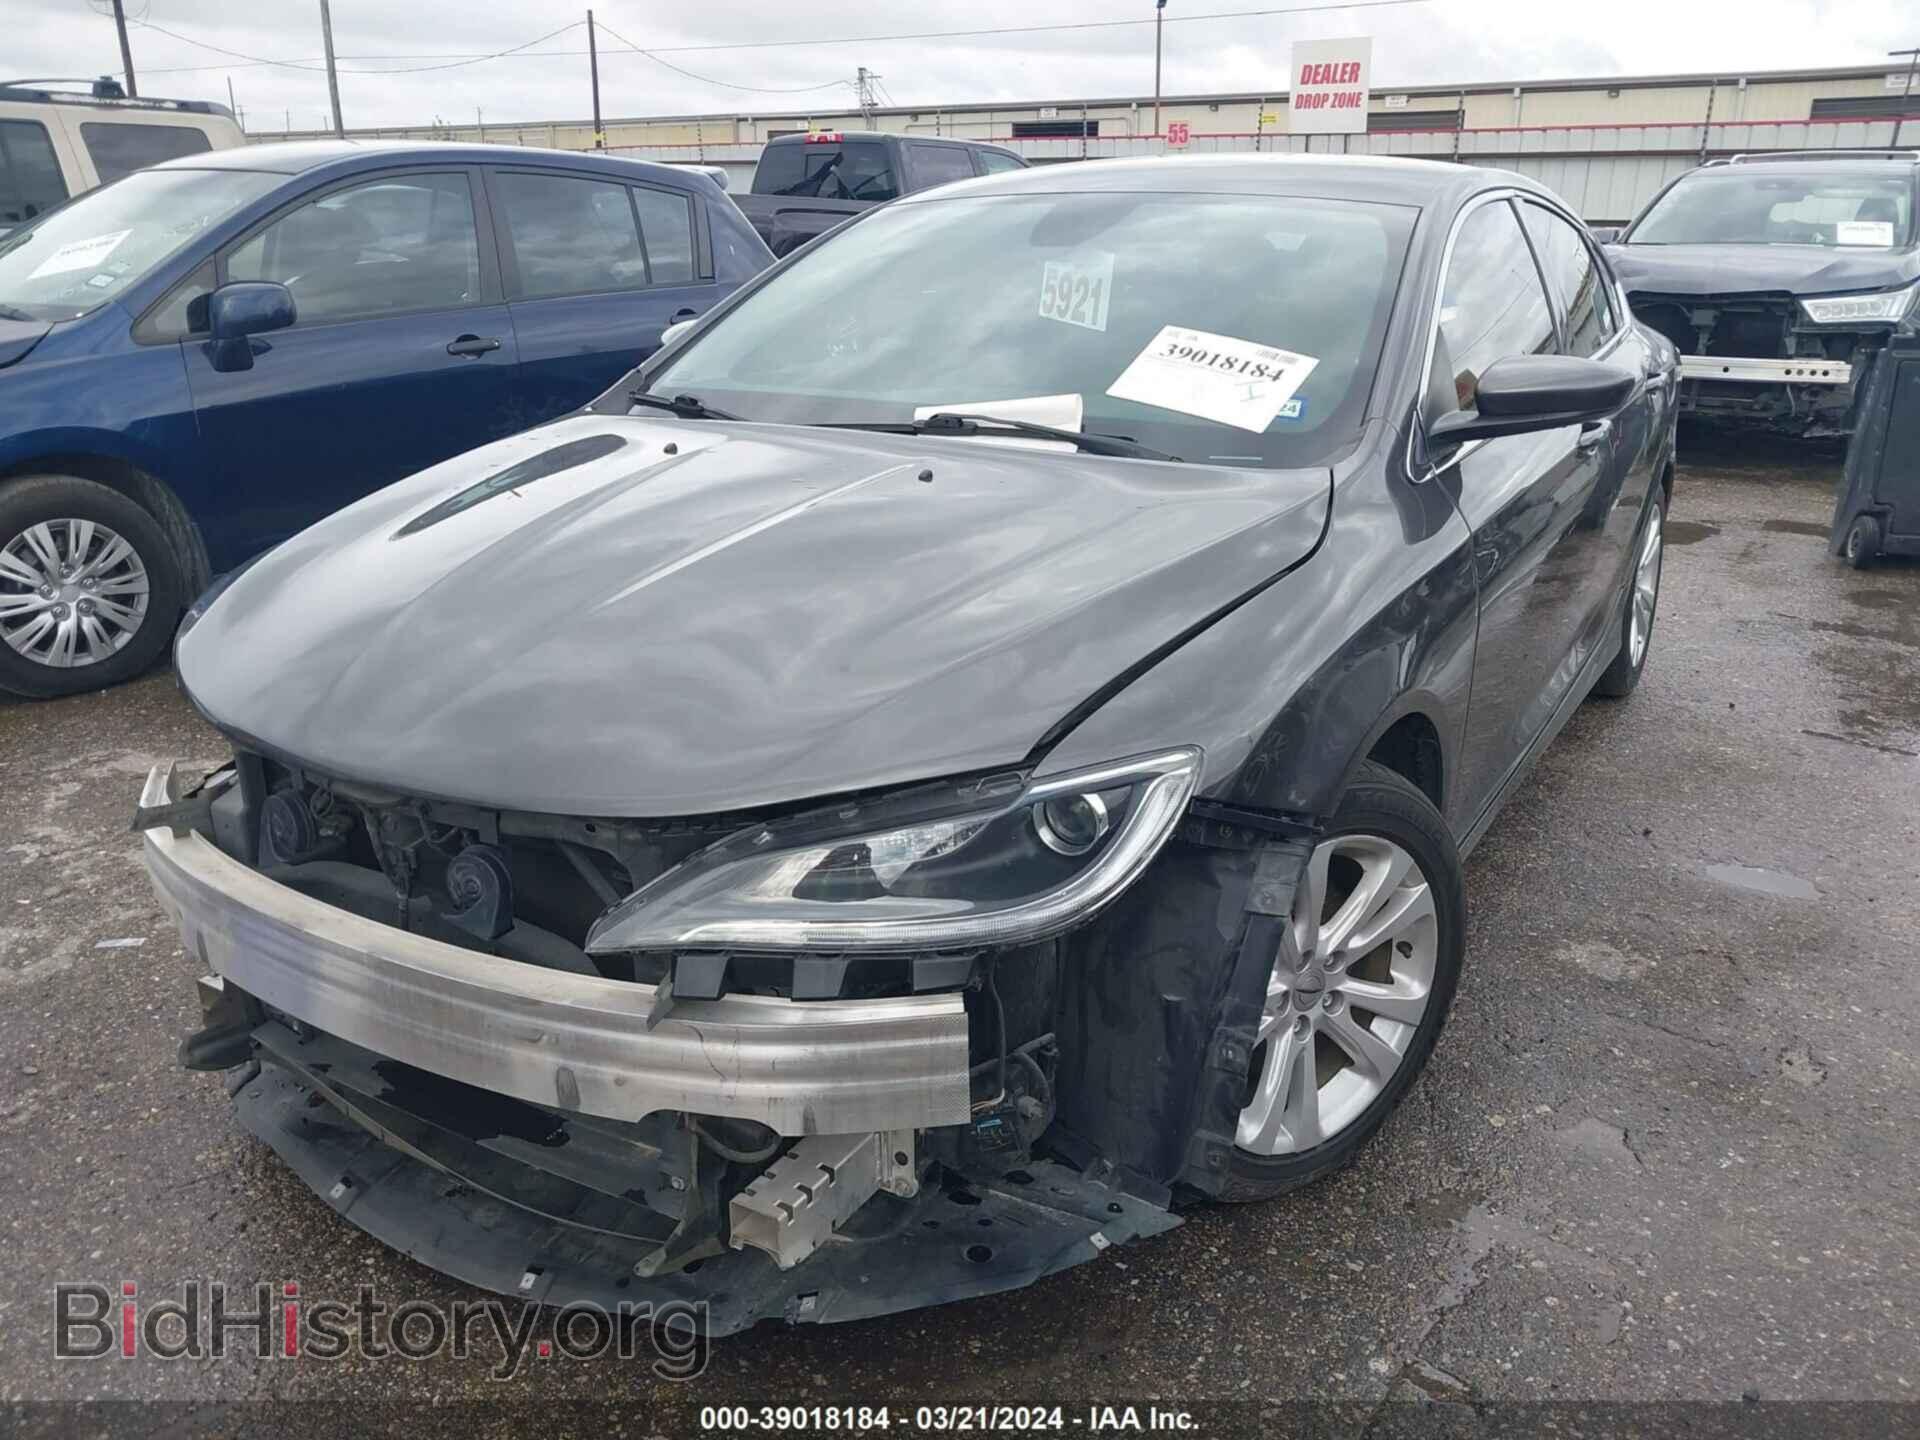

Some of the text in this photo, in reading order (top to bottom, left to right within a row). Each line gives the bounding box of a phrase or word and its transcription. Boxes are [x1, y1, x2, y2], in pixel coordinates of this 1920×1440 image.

[1300, 62, 1360, 85] DEALER
[1295, 92, 1363, 109] DROP ZONE
[1168, 123, 1188, 143] 55
[1041, 272, 1103, 326] 5921
[1159, 343, 1285, 382] 39018184
